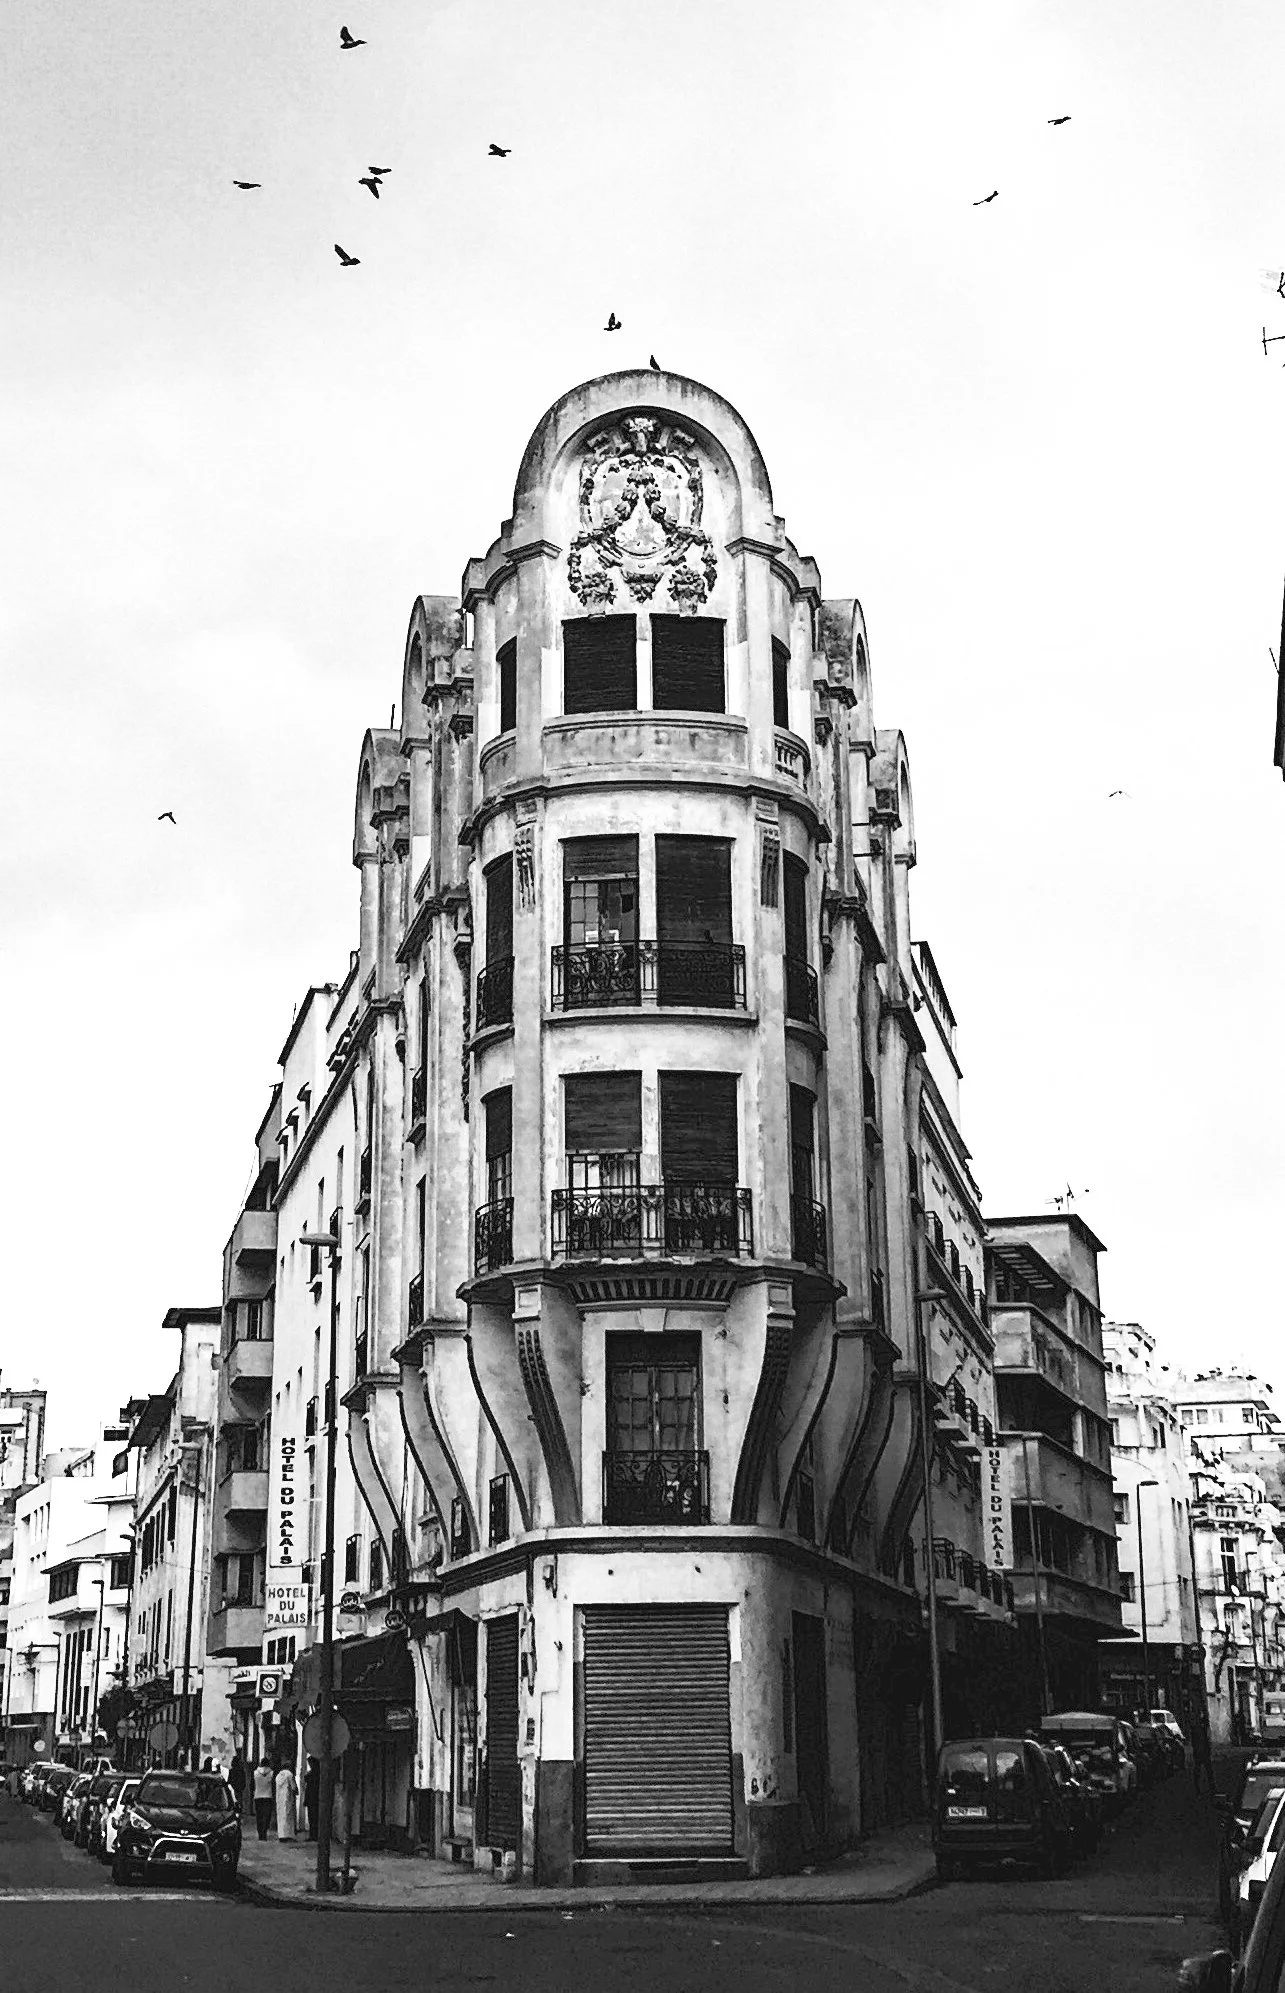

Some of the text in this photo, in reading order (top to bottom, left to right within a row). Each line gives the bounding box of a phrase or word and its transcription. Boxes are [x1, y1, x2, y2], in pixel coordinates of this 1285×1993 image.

[279, 1437, 296, 1564] HOTEL DU PALAIS
[988, 1449, 1005, 1567] HOTEL DU PALAIS
[268, 1587, 306, 1599] HOTEL
[279, 1600, 295, 1611] DU
[267, 1612, 306, 1624] PALAIS
